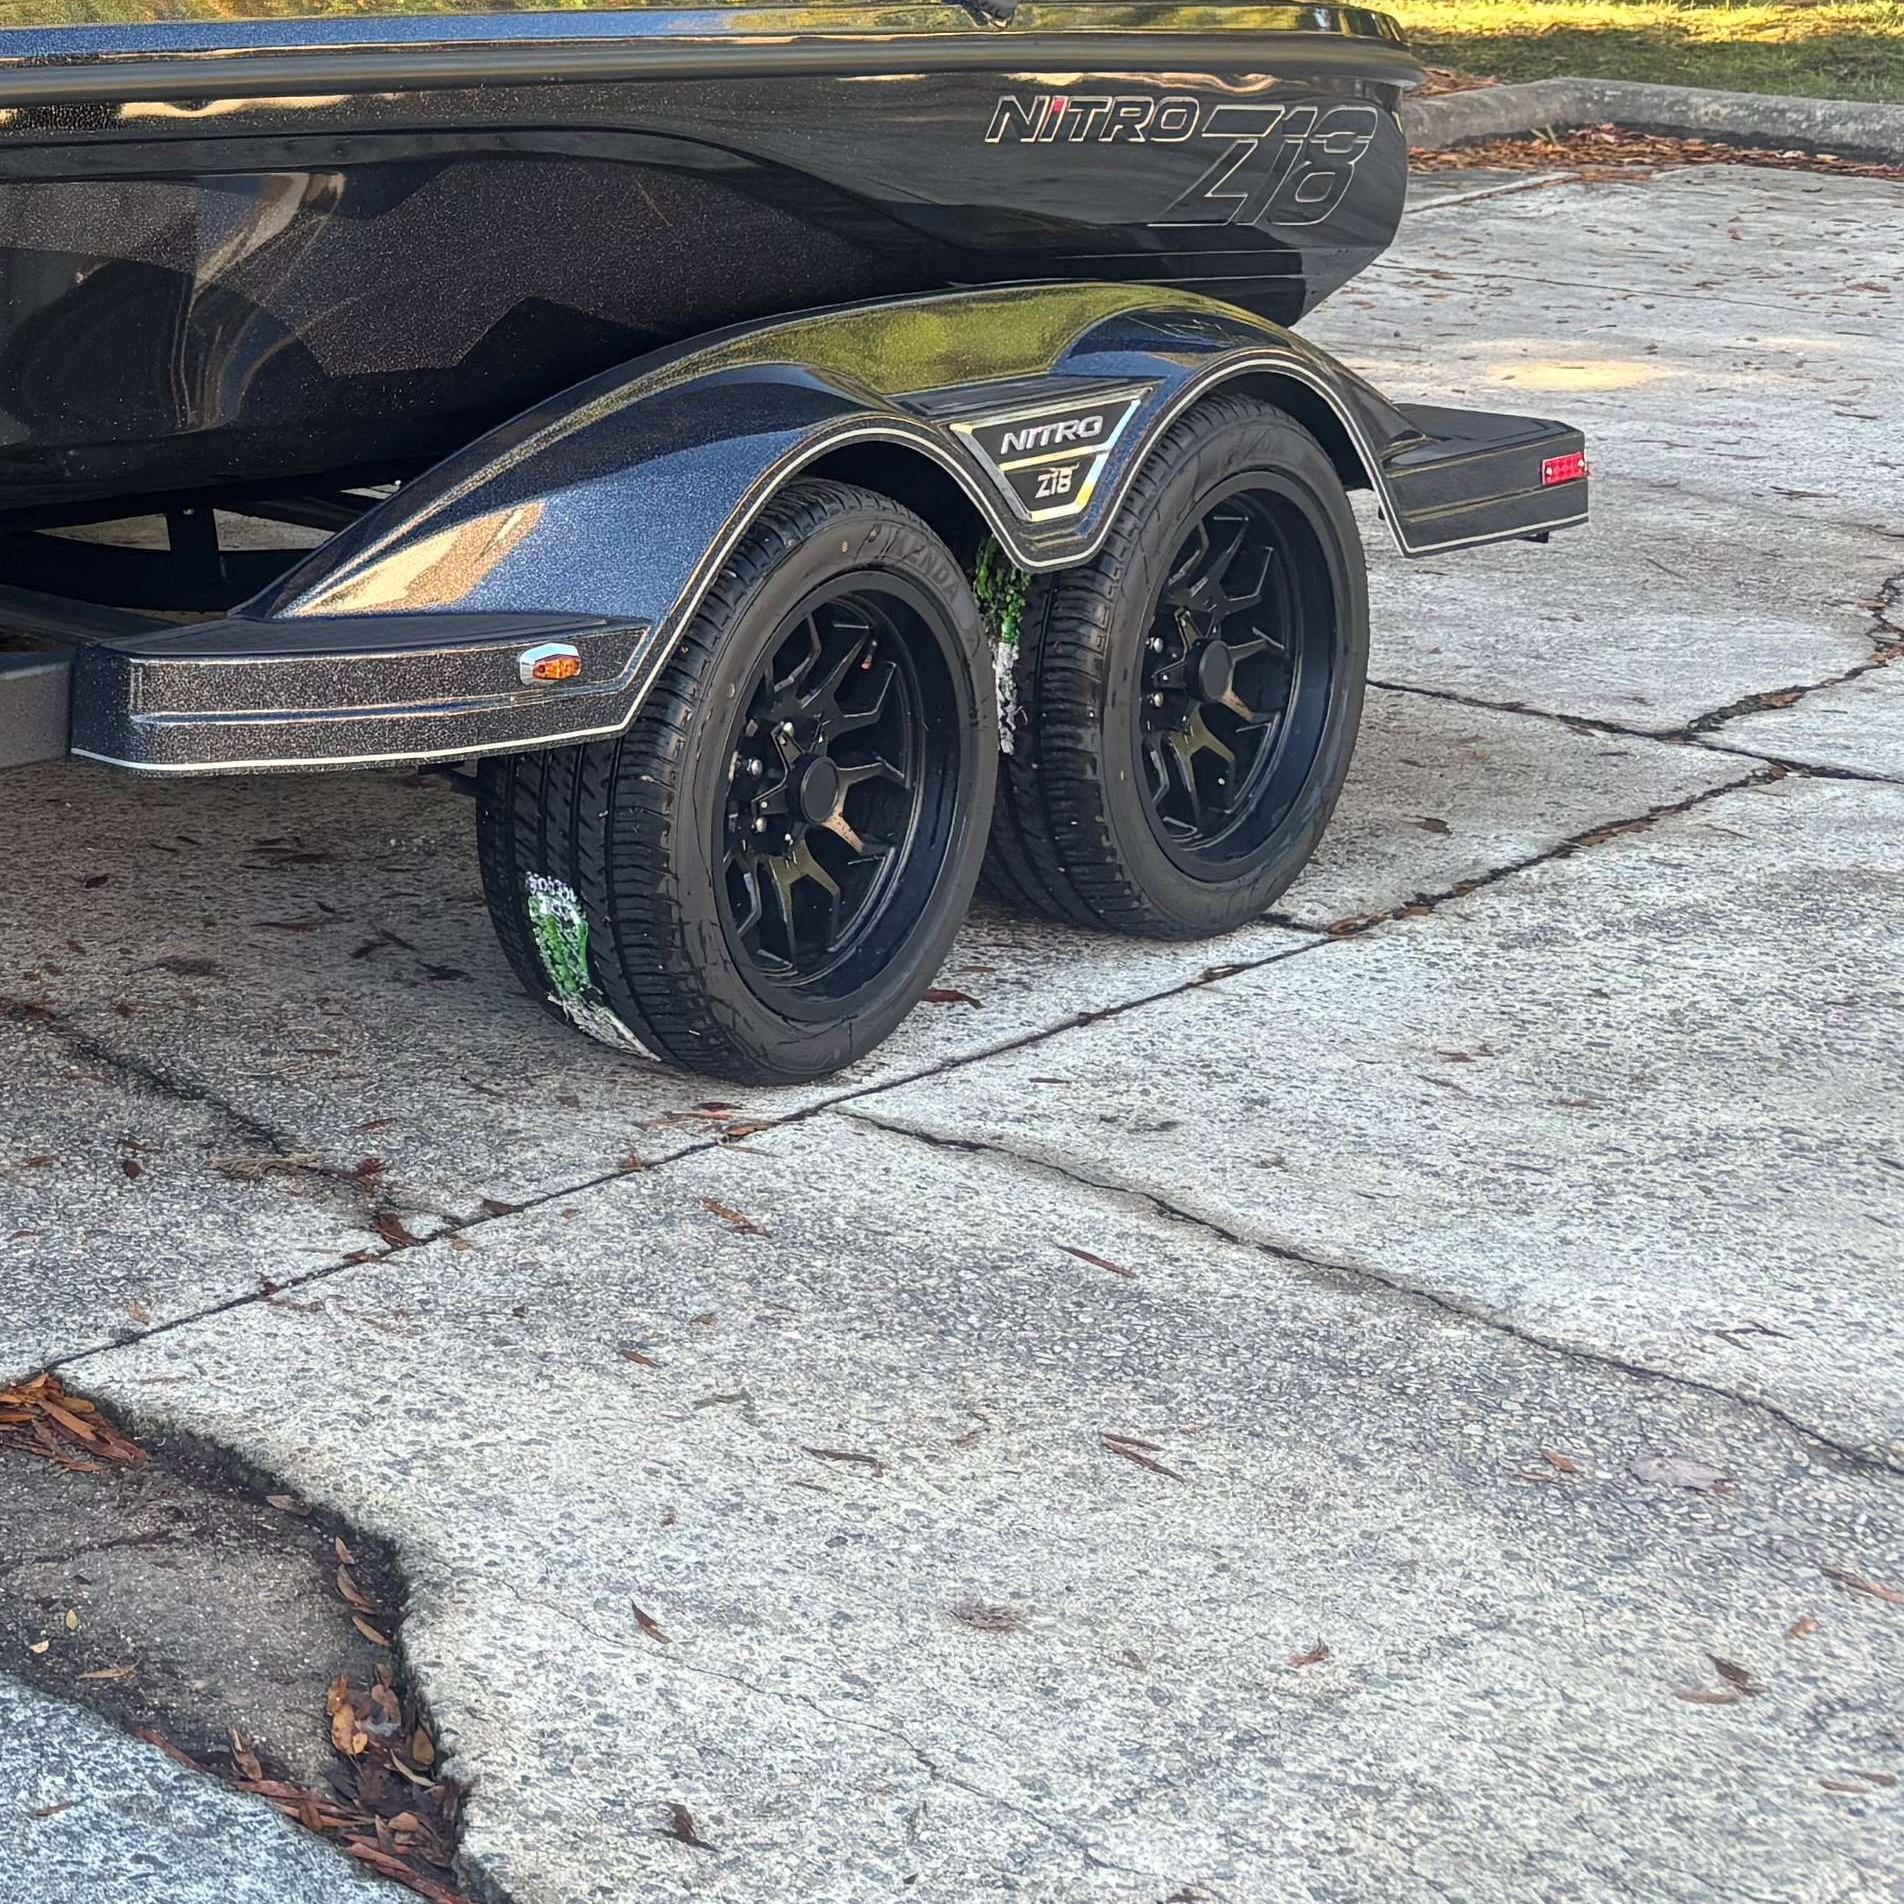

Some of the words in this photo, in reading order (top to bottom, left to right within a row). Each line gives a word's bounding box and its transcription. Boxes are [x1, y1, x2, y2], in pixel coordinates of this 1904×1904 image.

[1147, 104, 1379, 227] Z18
[1000, 415, 1103, 455] NITRO
[1035, 466, 1074, 498] Z18
